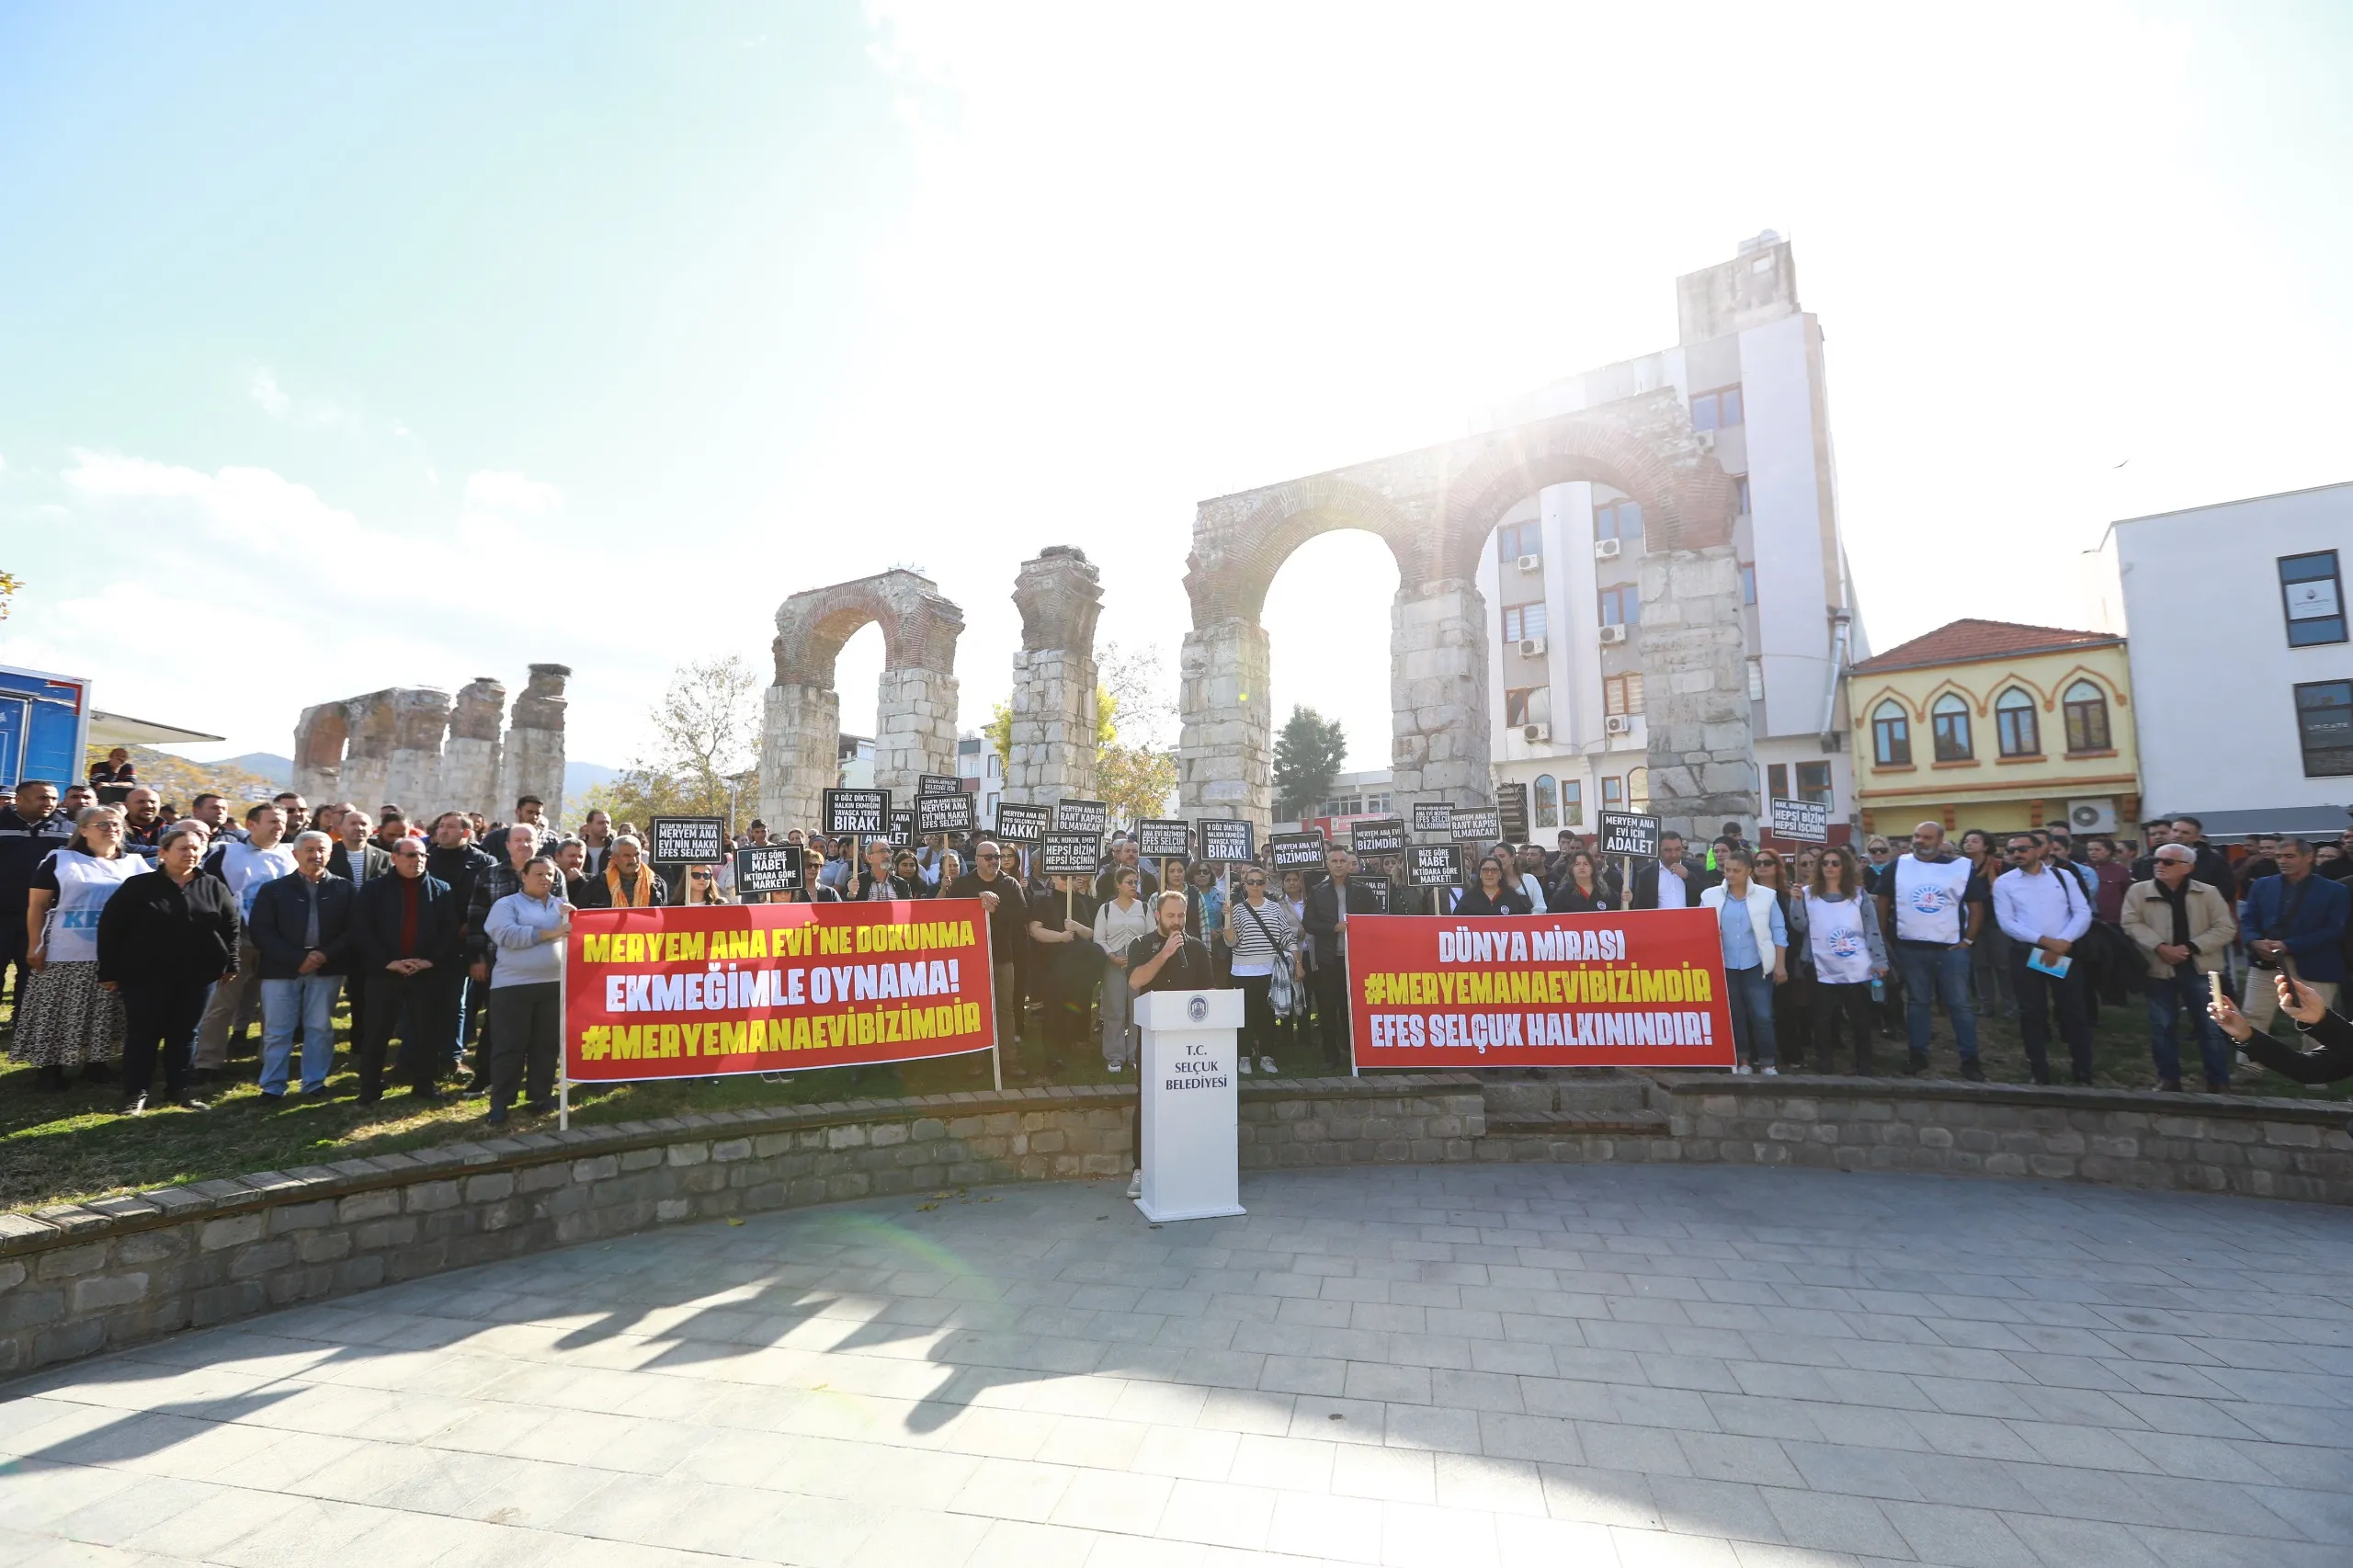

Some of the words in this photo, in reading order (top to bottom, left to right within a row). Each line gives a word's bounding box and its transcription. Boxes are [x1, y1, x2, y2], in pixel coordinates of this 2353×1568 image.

[854, 793, 880, 802] DİKTİĞİN
[921, 803, 951, 813] MERYEM
[953, 802, 967, 810] ANA
[1060, 805, 1082, 813] MERYEM
[1096, 807, 1104, 815] EVİ
[922, 811, 946, 821] EVİ'NİN
[947, 811, 968, 819] HAKKI
[1060, 813, 1079, 821] RANT
[1081, 814, 1104, 824] KAPISI
[1775, 809, 1800, 821] HEPSİ
[1802, 811, 1825, 824] BİZİM
[834, 816, 880, 830] BIRAK!
[922, 820, 938, 828] EFES
[939, 819, 968, 827] SELÇUK'A
[1060, 821, 1103, 832] OLMAYACAK!
[1223, 823, 1245, 832] DİKTİĞİN
[1452, 821, 1470, 830] RANT
[1473, 819, 1497, 829] KAPISI
[1606, 816, 1637, 826] MERYEM
[1639, 819, 1655, 828] ANA
[1775, 820, 1796, 830] HEPSİ
[659, 829, 697, 838] MERYEM
[699, 829, 717, 839] ANA
[1001, 823, 1038, 839] HAKKI
[1392, 827, 1401, 835] EVİ
[1453, 828, 1497, 838] OLMAYACAK!
[1616, 826, 1628, 837] EVİ
[1630, 827, 1646, 838] İÇİN
[659, 838, 689, 849] EVİ'NİN
[692, 840, 717, 849] HAKKI
[1161, 837, 1185, 846] SELÇUK
[1357, 835, 1401, 851] BİZİMDİR!
[1606, 836, 1654, 854] ADALET
[658, 849, 678, 857] EFES
[681, 849, 717, 858] SELÇUK'A
[1046, 844, 1071, 855] HEPSİ
[1073, 844, 1095, 855] BİZİM
[1142, 846, 1186, 854] HALKININDIR!
[1208, 845, 1247, 859] BIRAK!
[1419, 848, 1432, 857] BİZE
[1434, 847, 1449, 856] GÖRE
[752, 851, 767, 861] BİZE
[769, 850, 787, 859] GÖRE
[1046, 854, 1067, 864] HEPSİ
[1276, 849, 1321, 864] BİZİMDİR!
[752, 858, 787, 871] MABET
[1419, 856, 1449, 867] MABET
[744, 871, 776, 881] İKTİDARA
[778, 869, 796, 879] GÖRE
[1412, 867, 1441, 876] İKTİDARA
[1442, 866, 1458, 875] GÖRE
[753, 878, 788, 889] MARKET!
[1420, 875, 1452, 884] MARKET!
[63, 910, 99, 929] KE
[583, 932, 705, 962] MERYEM
[710, 929, 767, 959] ANA
[771, 922, 853, 957] EVİ'NE
[856, 920, 975, 953] DOKUNMA
[1438, 926, 1528, 963] DÜNYA
[1531, 924, 1626, 961] MİRASI
[606, 961, 805, 1011] EKMEĞİMLE
[810, 959, 960, 1003] OYNAMA!
[1364, 962, 1712, 1005] #MERYEMANAEVİBİZİMDİR
[581, 997, 981, 1060] #MERYEMANAEVİBİZİMDİR
[1370, 1014, 1426, 1047] EFES
[1429, 1013, 1523, 1054] SELÇUK
[1526, 1012, 1712, 1046] HALKININDIR!
[1186, 1045, 1207, 1055] T.C.
[1175, 1061, 1218, 1075] SELÇUK
[1166, 1074, 1227, 1090] BELEDİYESİ
